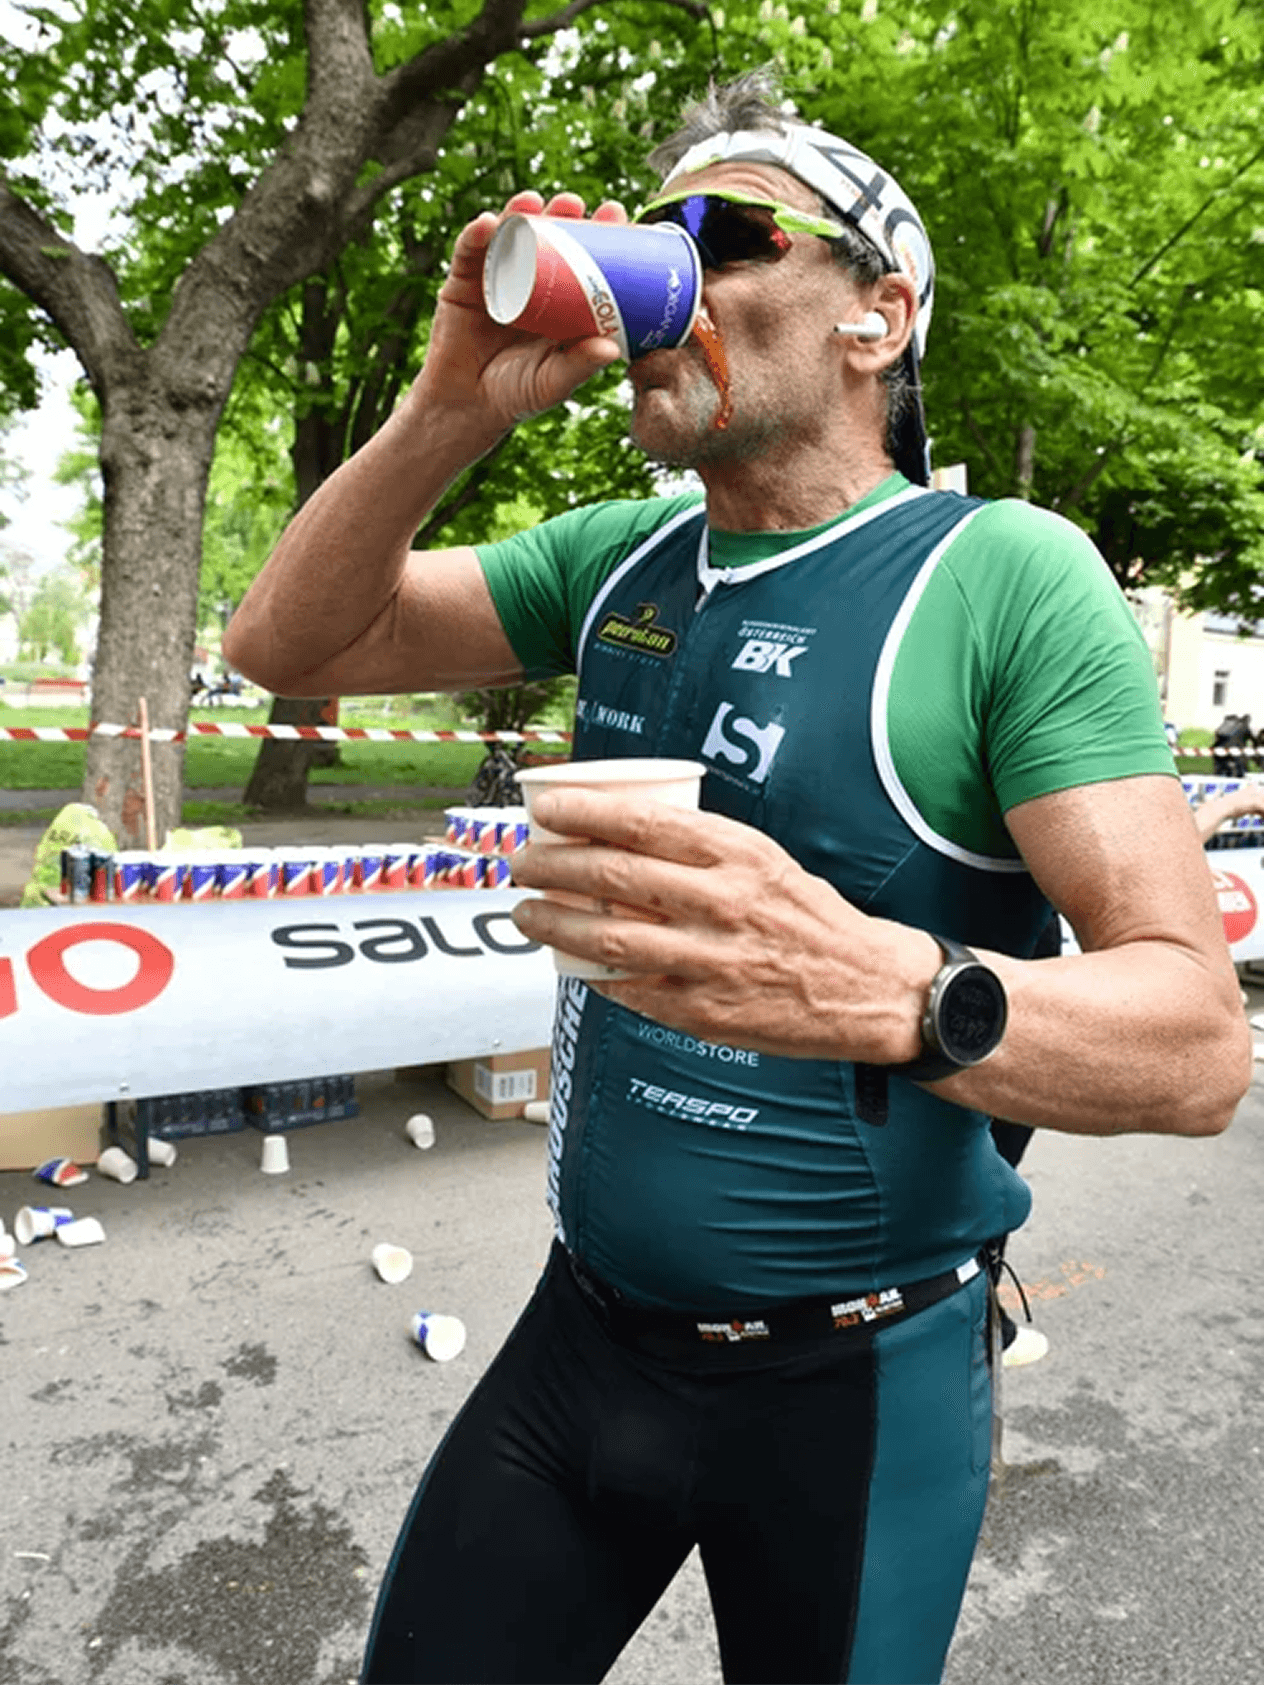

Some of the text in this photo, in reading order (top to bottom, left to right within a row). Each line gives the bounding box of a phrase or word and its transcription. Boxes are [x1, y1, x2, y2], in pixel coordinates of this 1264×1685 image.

[731, 638, 810, 678] BK
[0, 922, 175, 1018] O
[636, 1021, 760, 1068] WORLDSTORE
[629, 1077, 760, 1124] TEASPO
